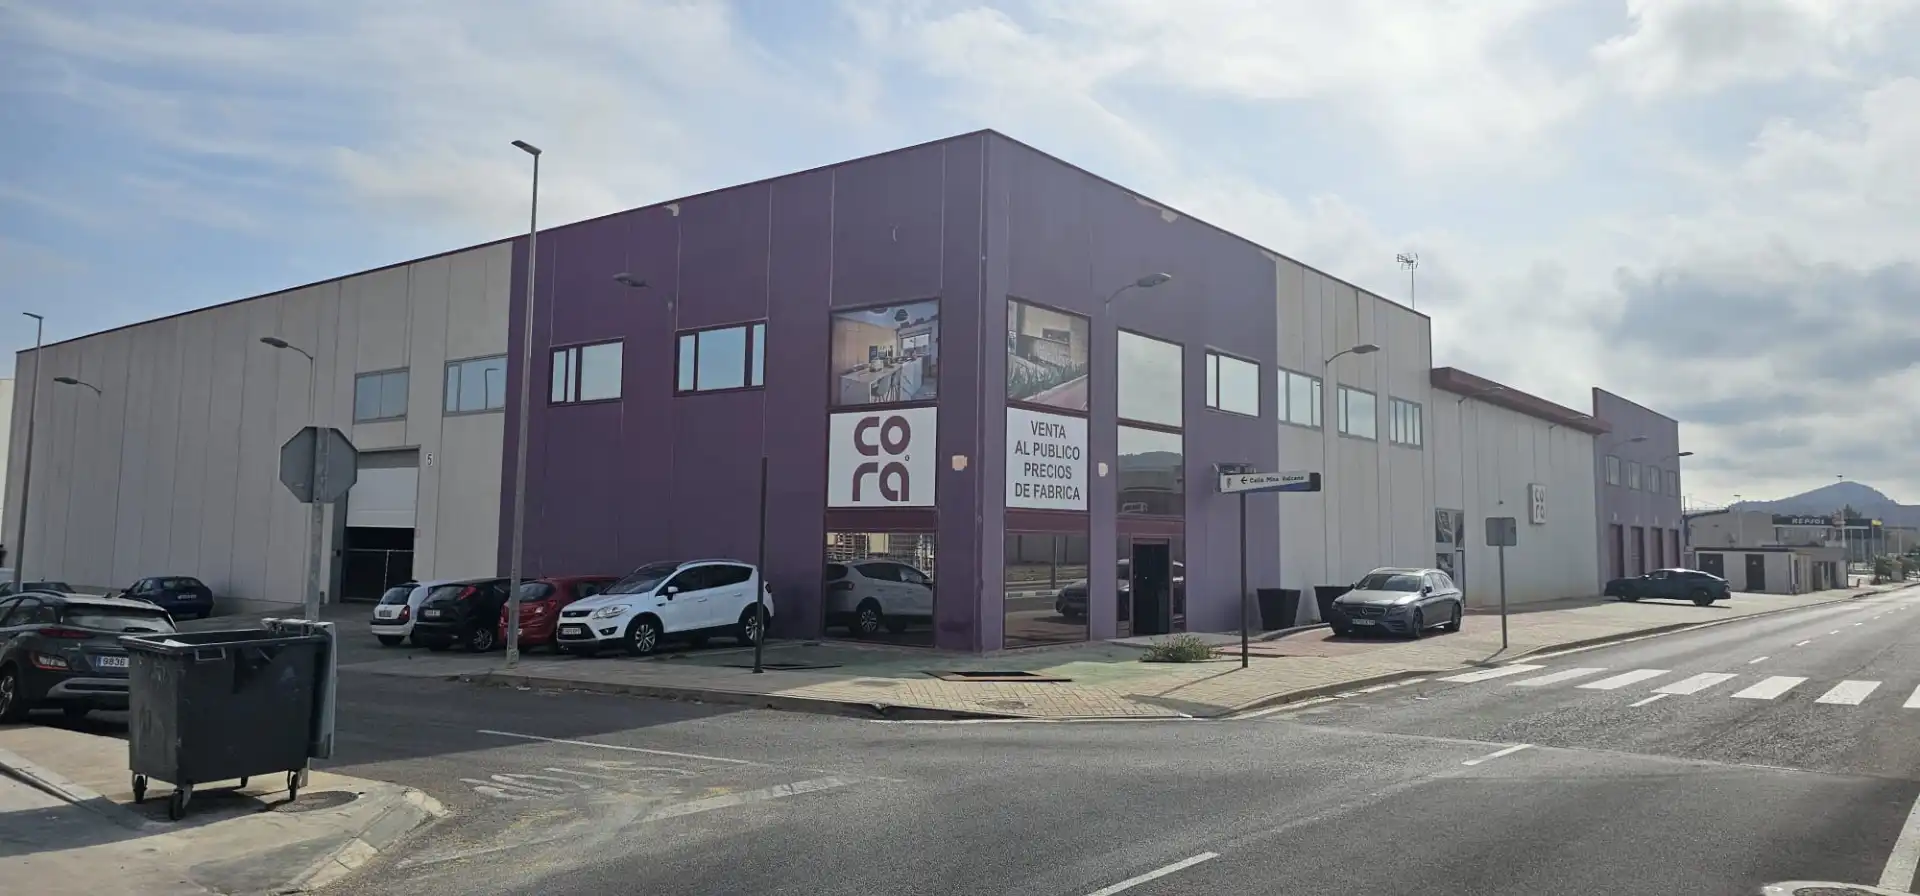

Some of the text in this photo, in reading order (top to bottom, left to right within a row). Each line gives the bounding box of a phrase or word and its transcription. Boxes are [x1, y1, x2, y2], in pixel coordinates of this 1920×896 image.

[1030, 420, 1067, 439] VENTA
[1014, 440, 1080, 460] AL PUBLICO
[1024, 462, 1072, 480] PRECIOS
[1015, 482, 1080, 501] DE FABRICA
